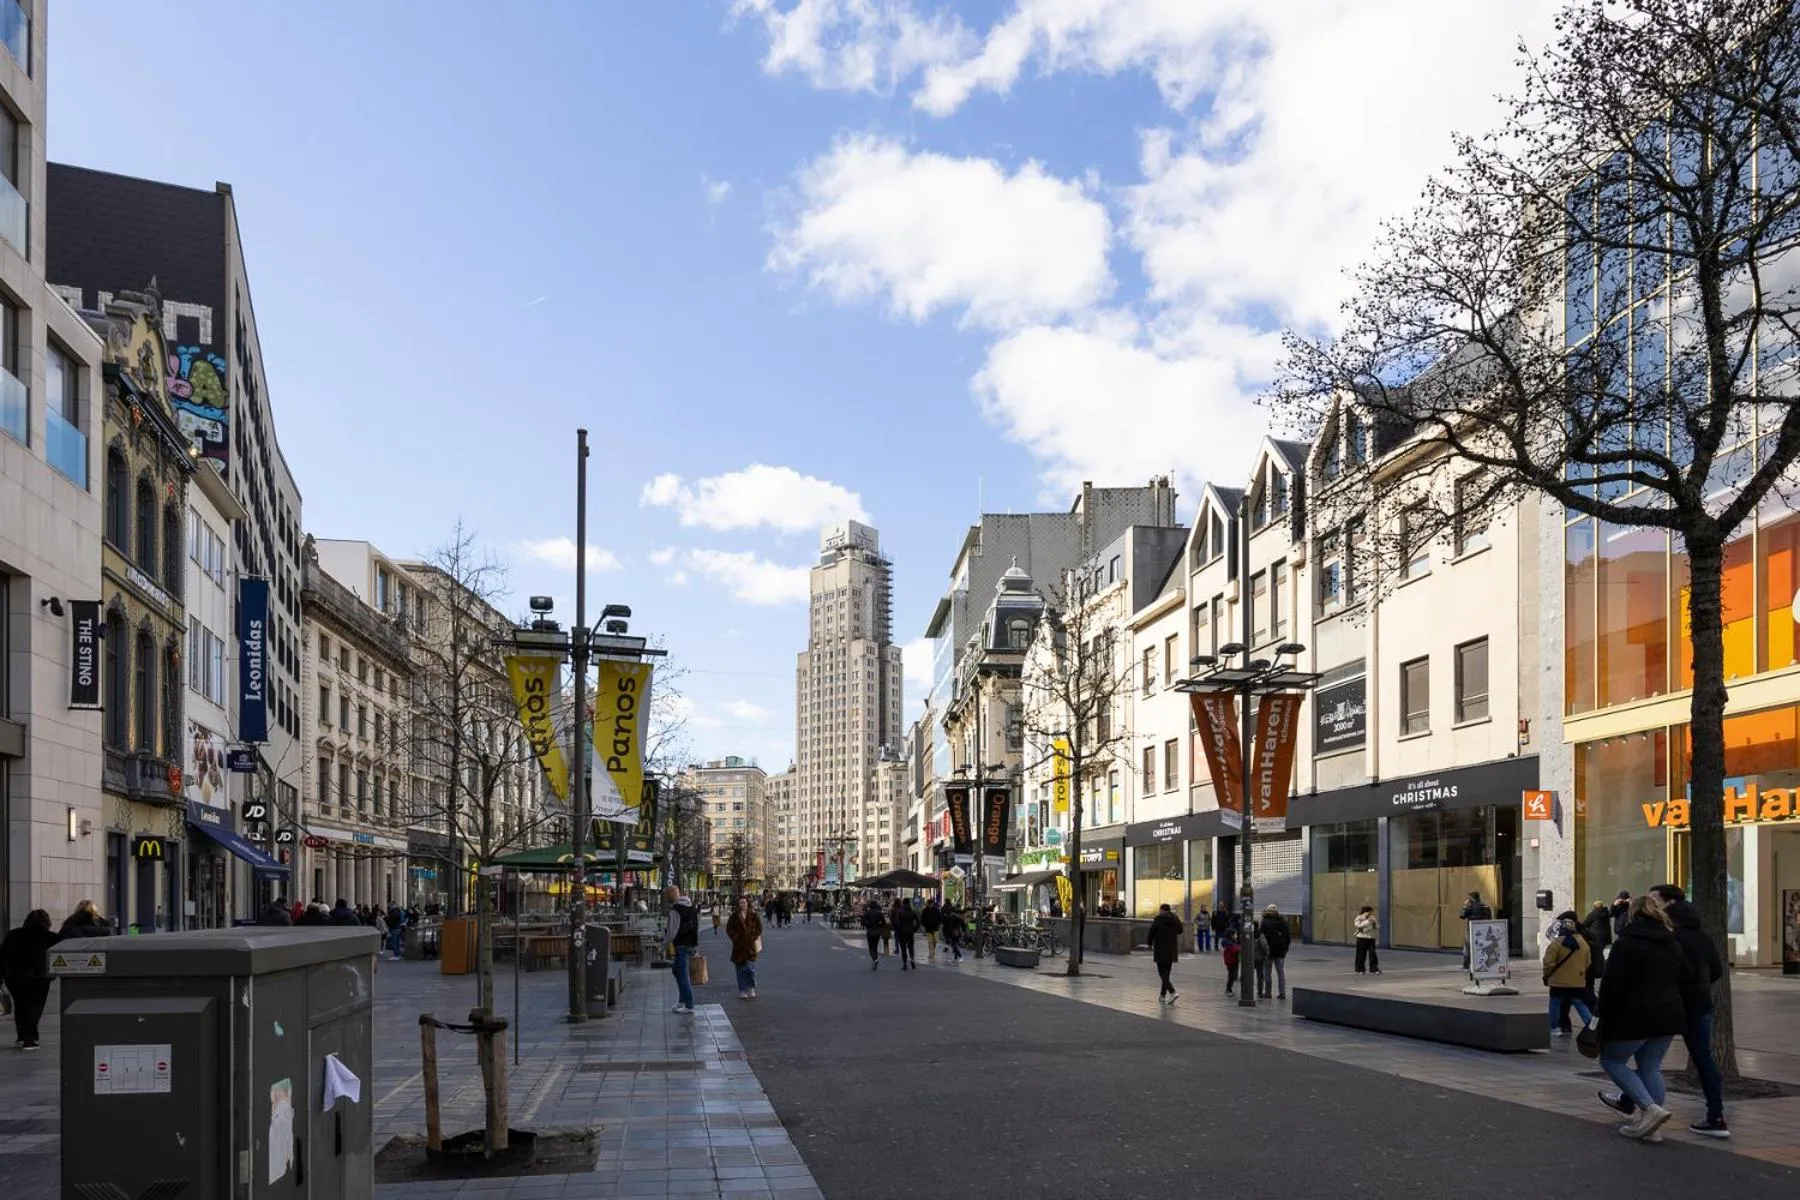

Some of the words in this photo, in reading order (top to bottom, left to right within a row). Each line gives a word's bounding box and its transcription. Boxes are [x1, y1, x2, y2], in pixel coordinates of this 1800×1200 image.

[79, 619, 92, 643] THE
[79, 647, 92, 686] STING
[245, 619, 262, 701] Leonidas
[606, 676, 636, 773] Panos
[1260, 699, 1283, 811] vanHaren
[1056, 757, 1066, 803] TORFS
[1392, 786, 1458, 805] CHRISTMAS
[244, 805, 266, 818] JD
[988, 793, 1005, 845] Orange
[1641, 783, 1800, 828] vaHa
[277, 832, 292, 841] JD
